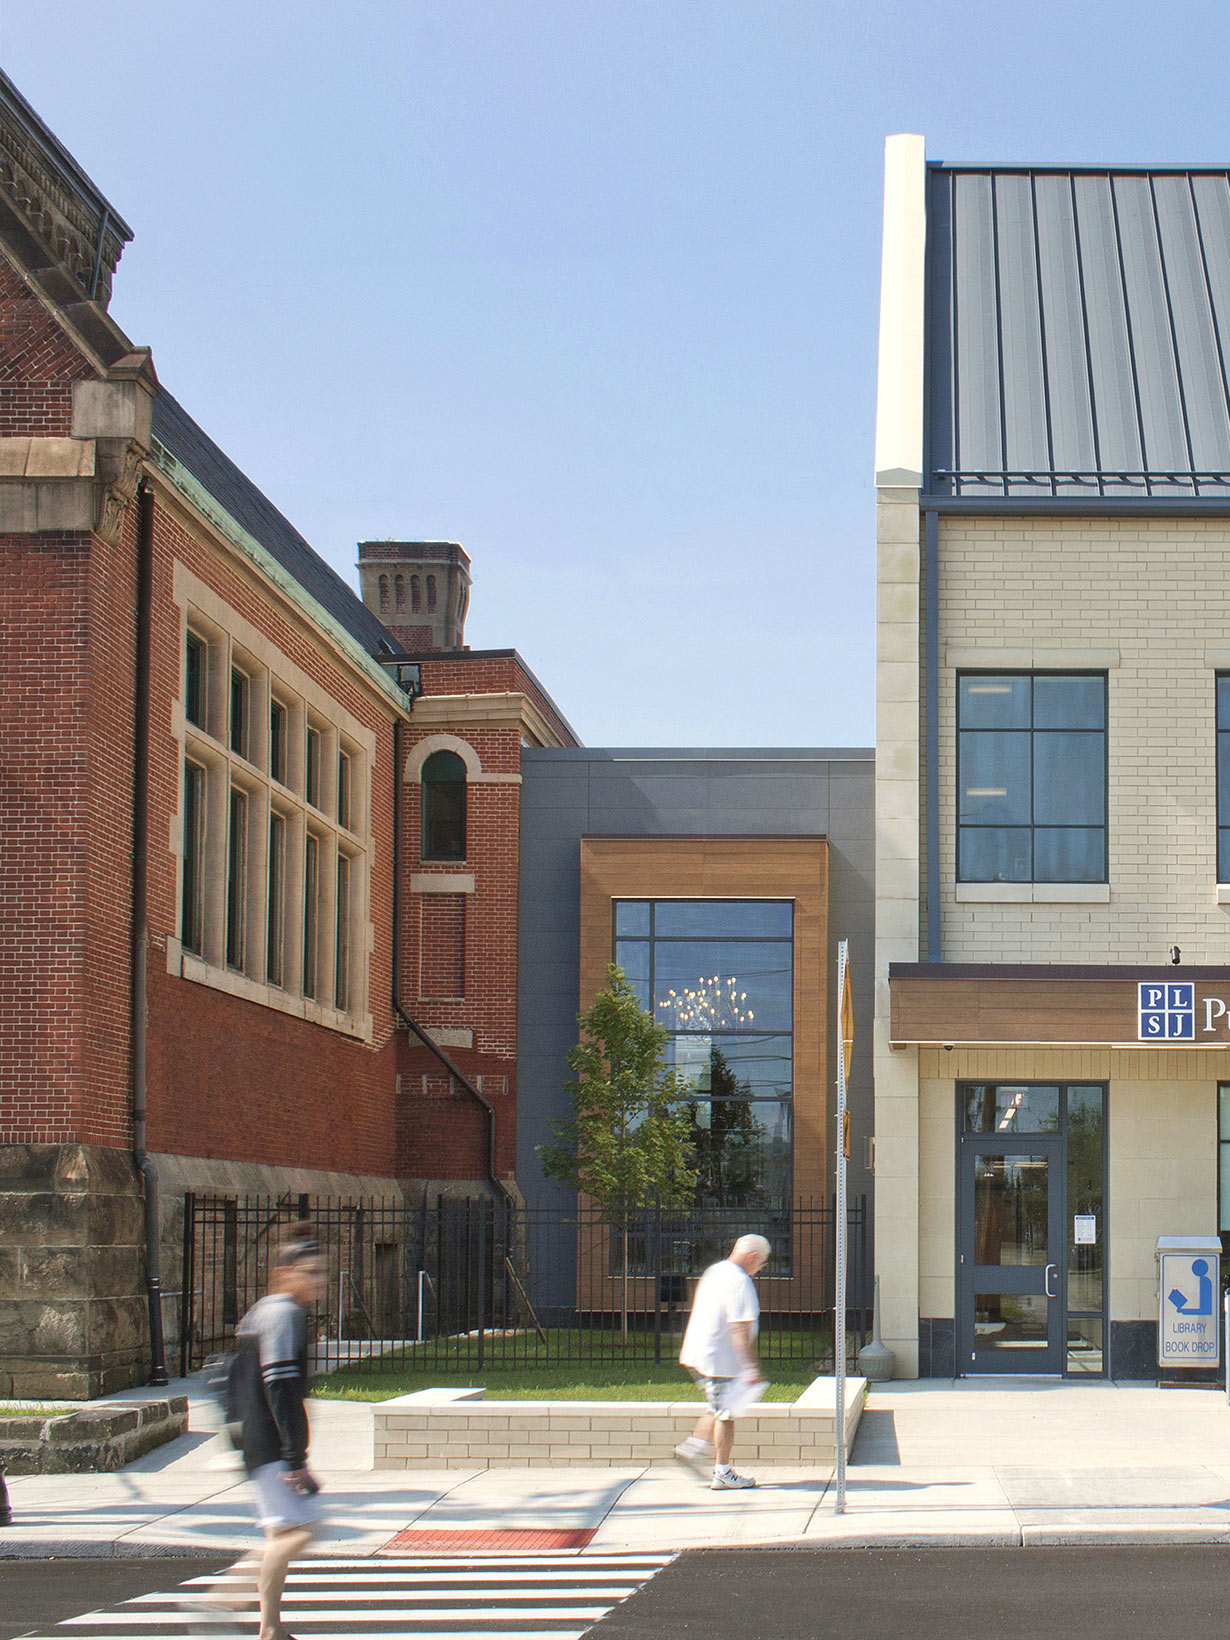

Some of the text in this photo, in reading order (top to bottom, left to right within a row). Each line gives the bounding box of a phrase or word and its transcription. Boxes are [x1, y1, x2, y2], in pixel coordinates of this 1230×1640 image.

[1172, 1322, 1207, 1334] LIBRARY
[1165, 1341, 1215, 1353] BOOK DROP
